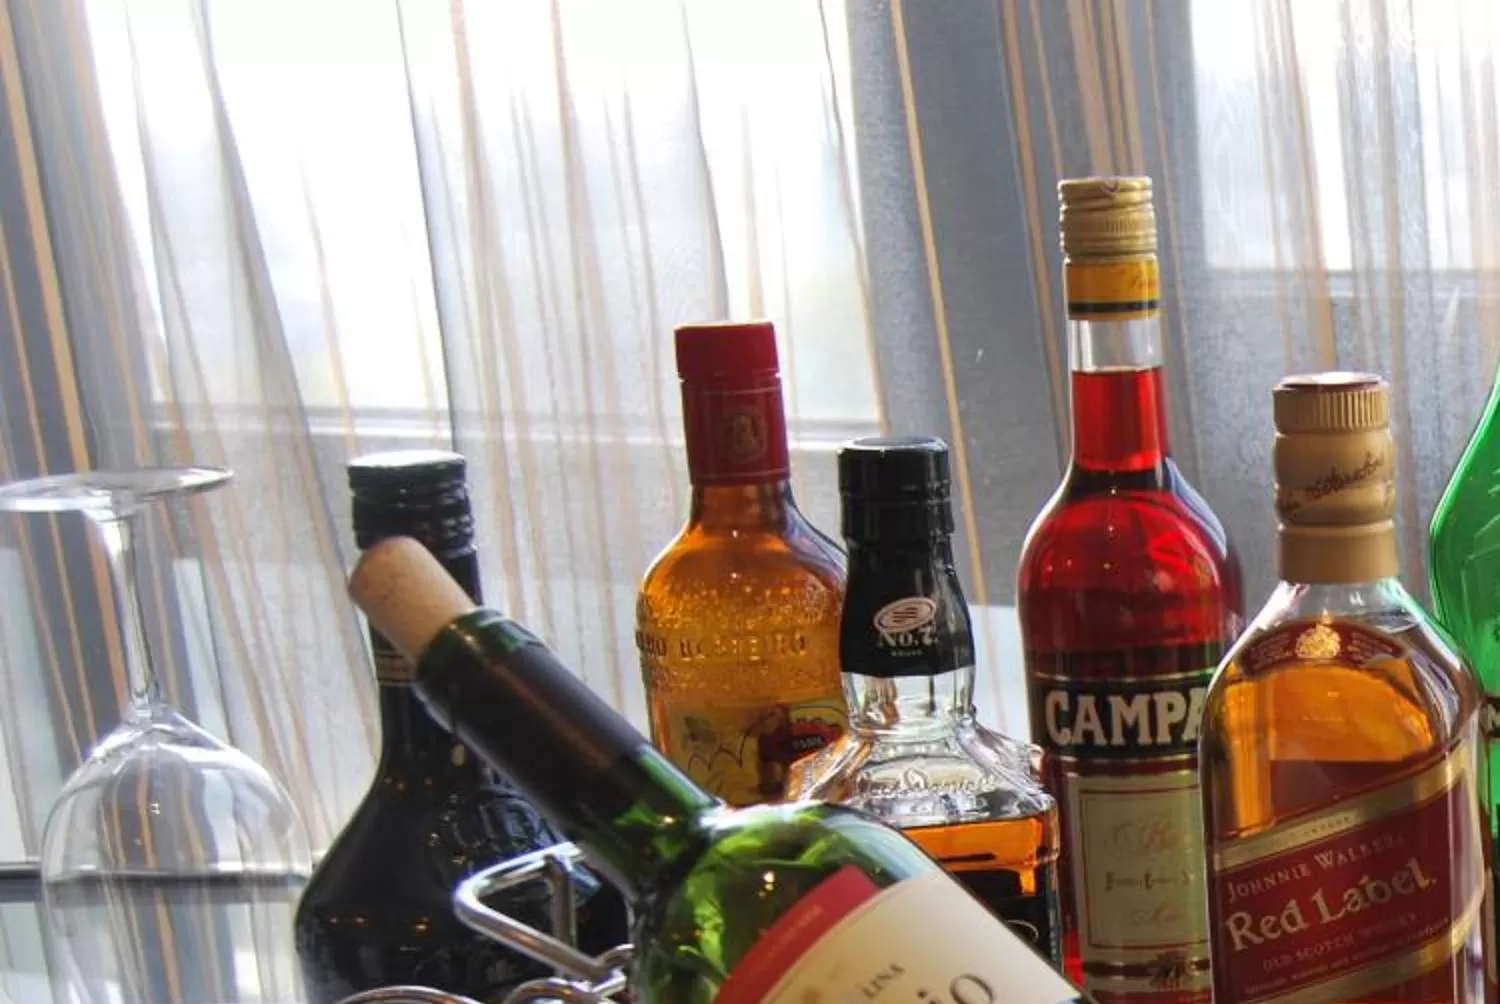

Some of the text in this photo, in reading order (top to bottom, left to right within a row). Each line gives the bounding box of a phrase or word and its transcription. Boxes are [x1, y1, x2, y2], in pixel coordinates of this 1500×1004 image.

[1045, 688, 1209, 747] CAMPA
[1227, 863, 1312, 903] JOHNNIE
[1224, 898, 1311, 951] Red
